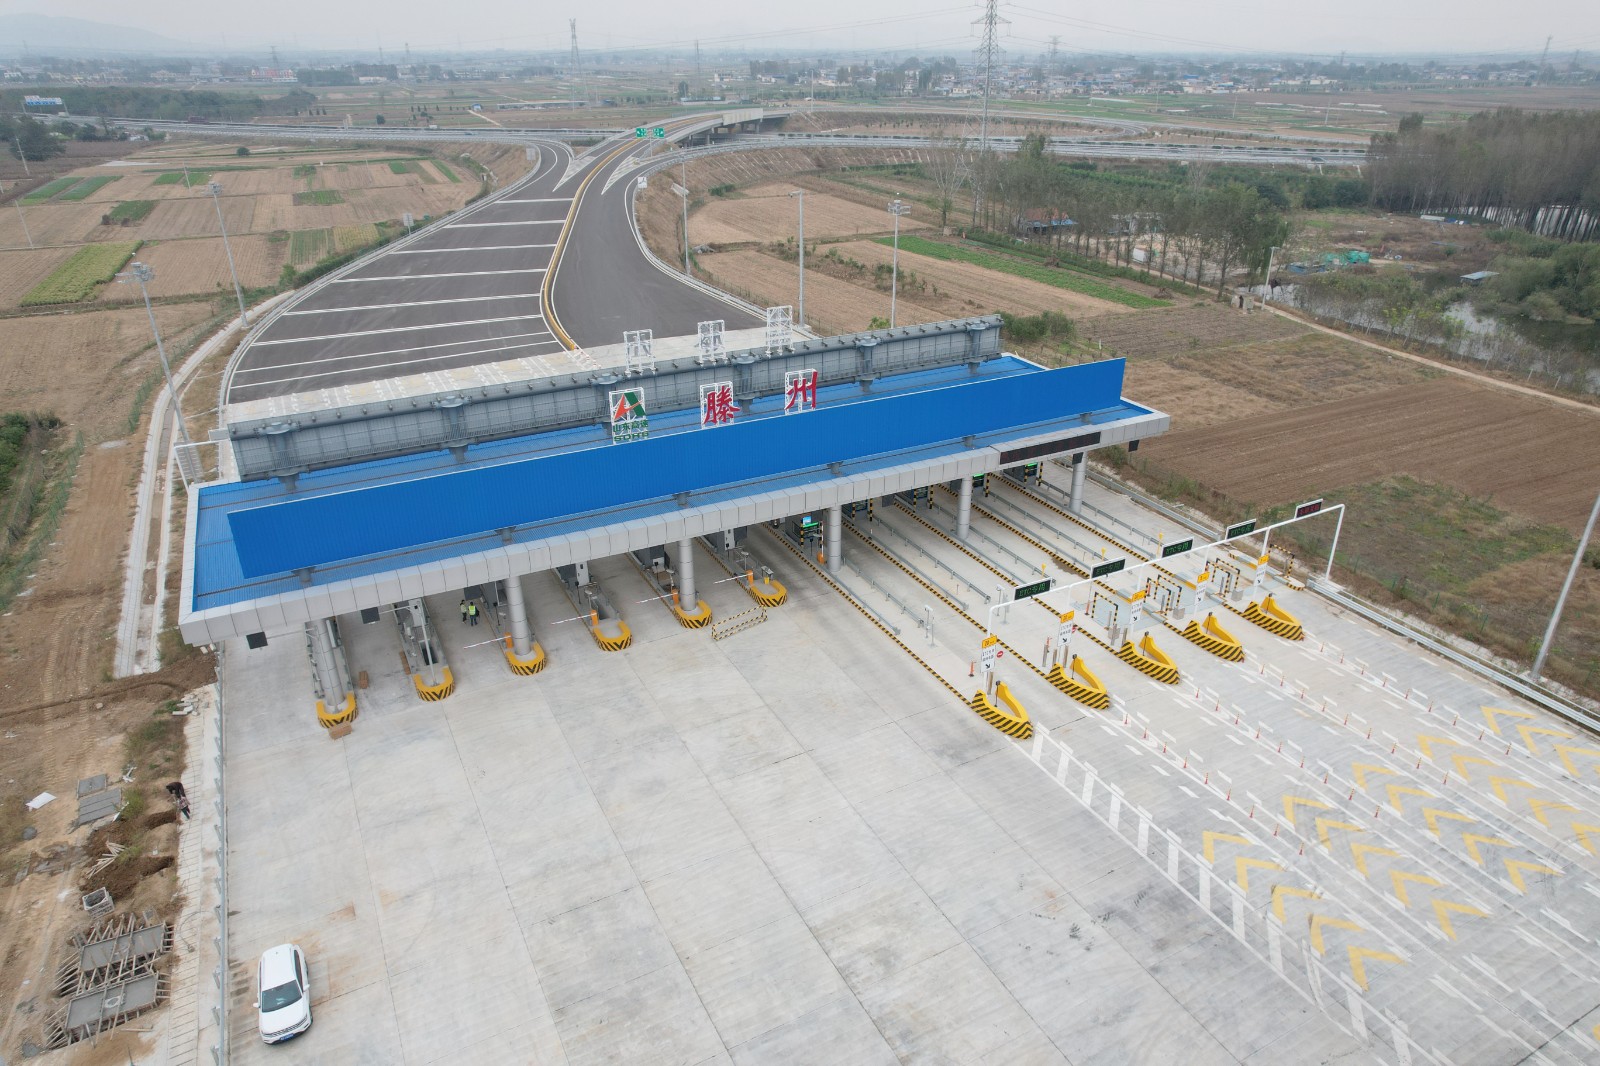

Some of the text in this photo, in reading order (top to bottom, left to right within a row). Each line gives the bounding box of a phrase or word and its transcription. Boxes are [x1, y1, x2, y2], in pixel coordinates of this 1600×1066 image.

[703, 371, 818, 424] 滕州
[613, 419, 649, 433] 山东高速
